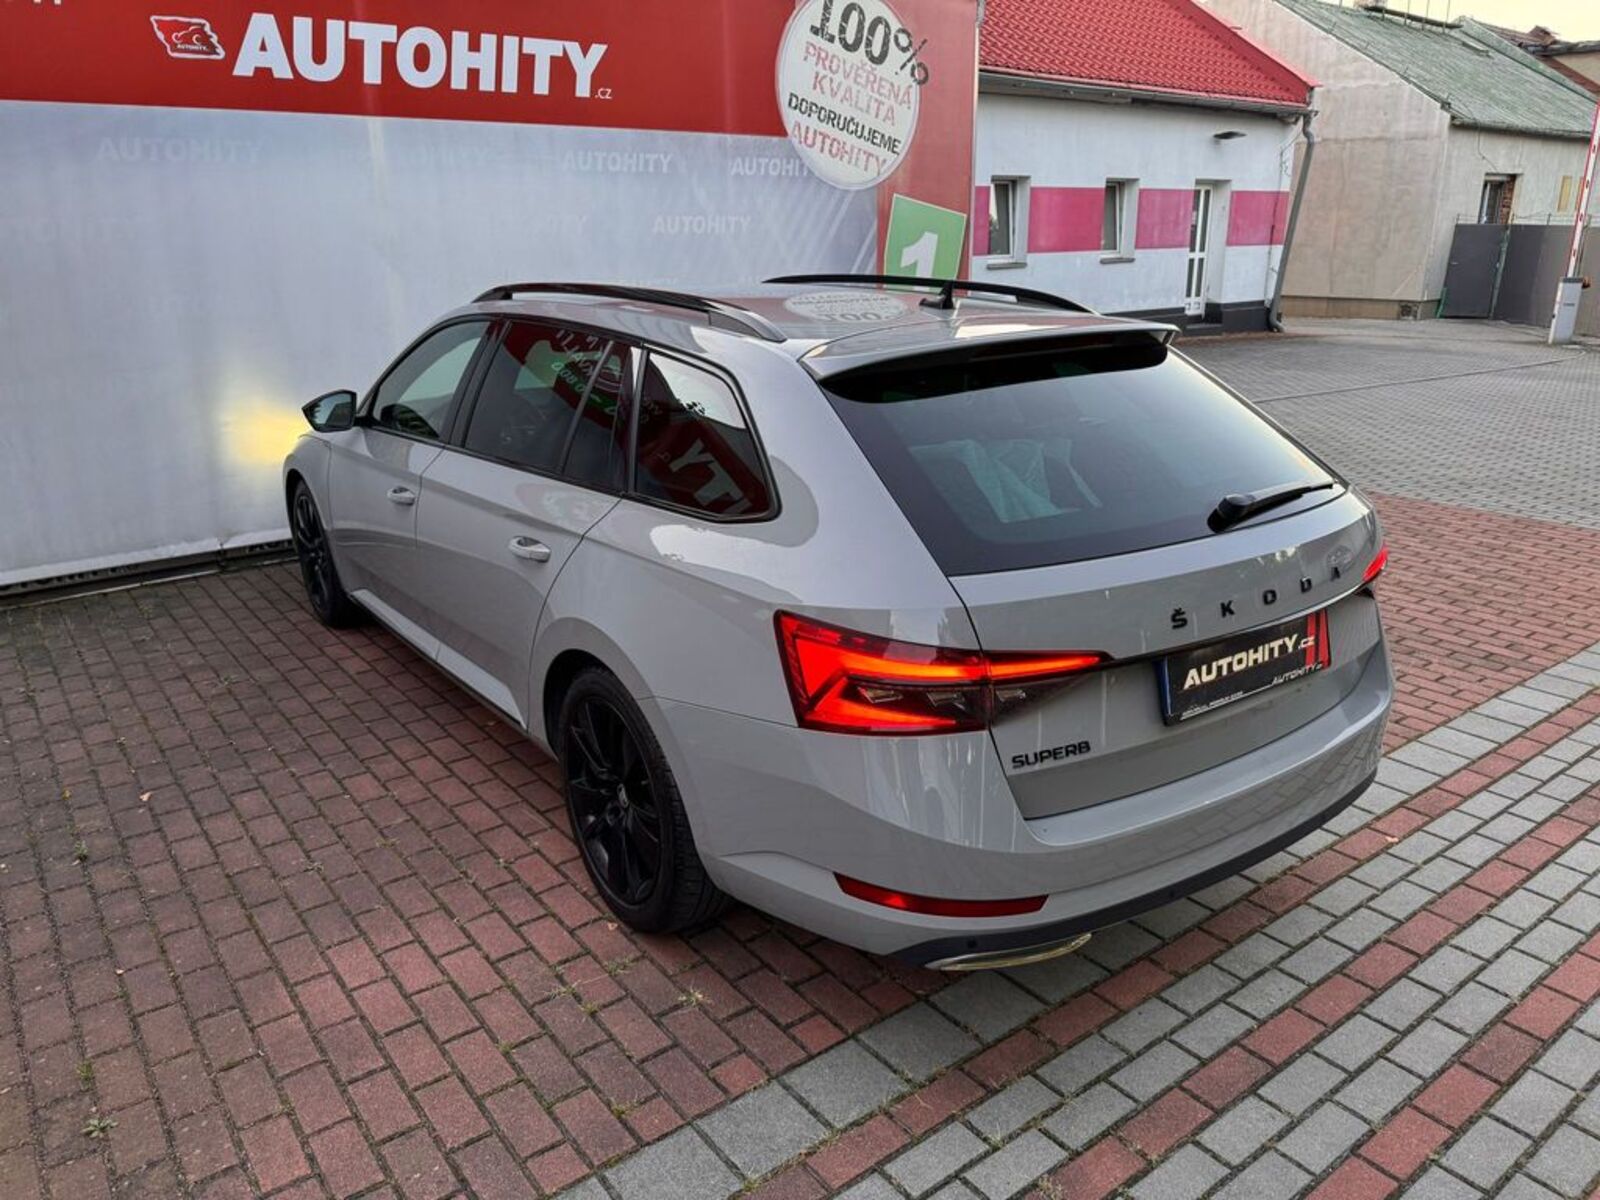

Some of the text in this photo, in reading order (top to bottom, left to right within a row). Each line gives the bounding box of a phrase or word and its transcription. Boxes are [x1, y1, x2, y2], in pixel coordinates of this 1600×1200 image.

[810, 0, 929, 85] 100%
[803, 41, 913, 110] PROVĚŘENÁ
[812, 72, 896, 126] KVALITA
[788, 92, 902, 156] DOPORUČUJEME
[792, 120, 887, 176] AUTOHITY
[562, 150, 672, 175] AUTOHITY
[652, 214, 752, 235] AUTOHITY
[900, 231, 938, 291] 1
[1171, 566, 1341, 630] ŠKODA
[1011, 740, 1091, 769] SUPERB
